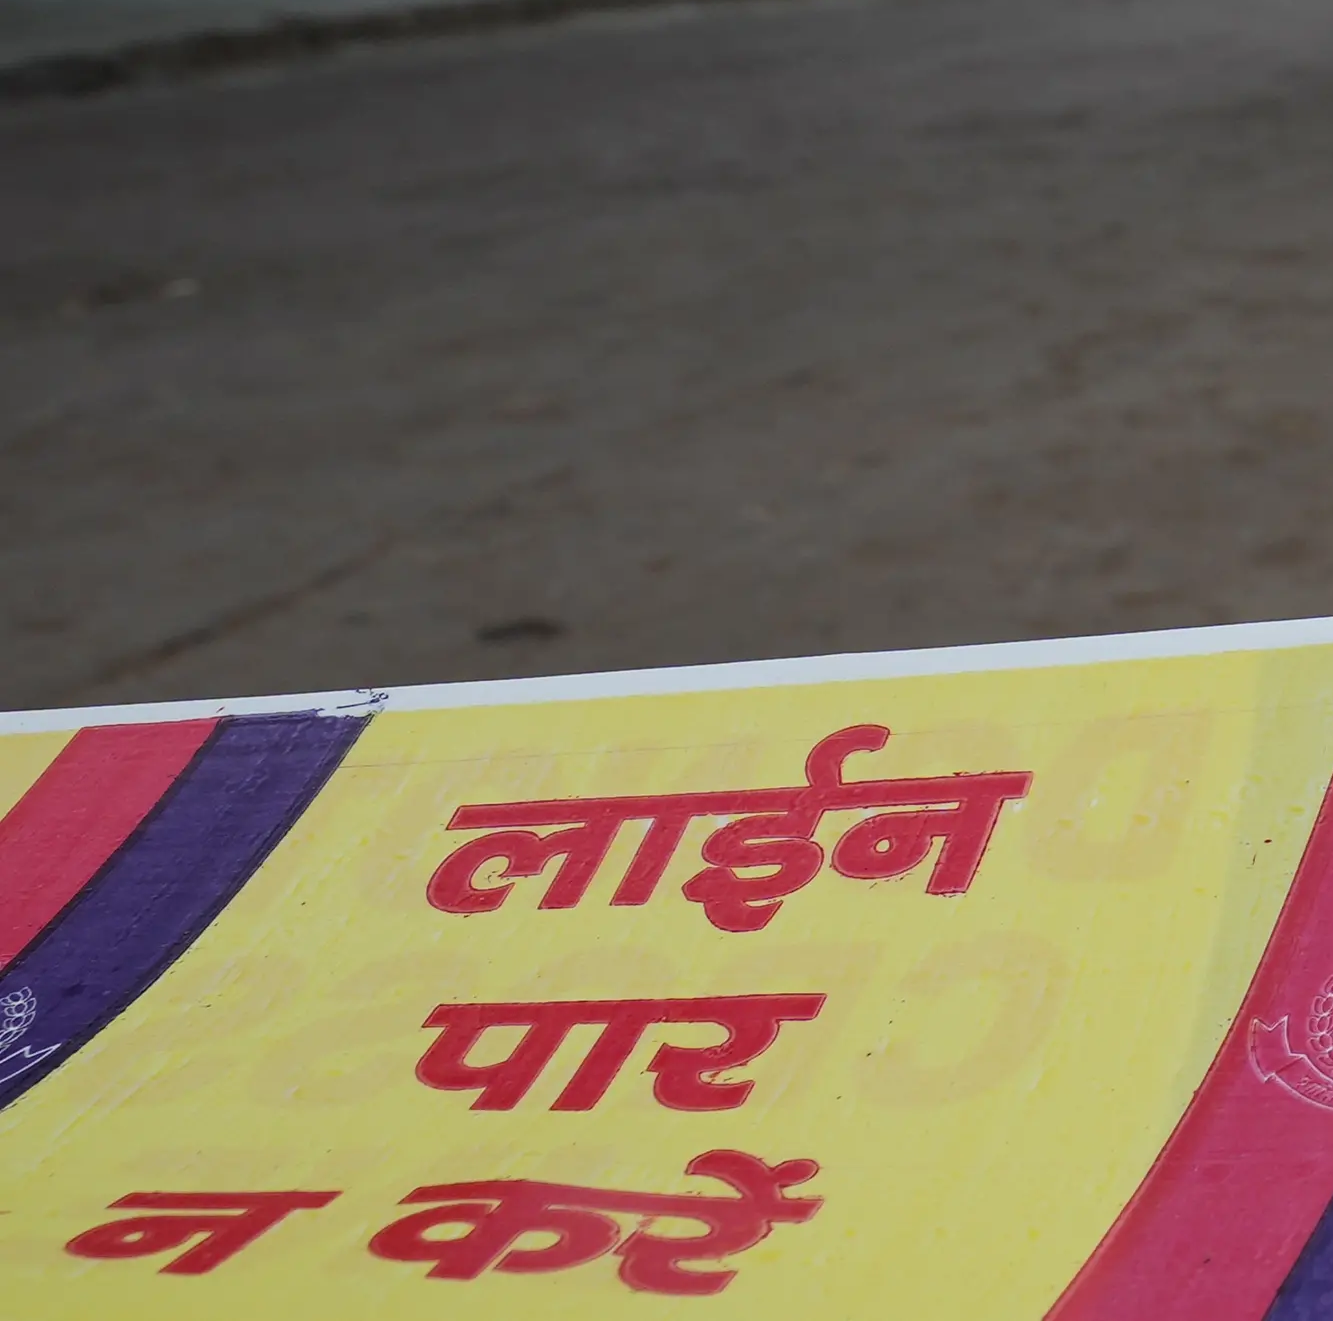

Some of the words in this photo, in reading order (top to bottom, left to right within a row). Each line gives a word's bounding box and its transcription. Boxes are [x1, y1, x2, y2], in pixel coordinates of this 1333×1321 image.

[426, 723, 1033, 934] लाईन
[415, 992, 827, 1113] पार
[65, 1190, 342, 1275] न
[367, 1149, 824, 1296] करें
